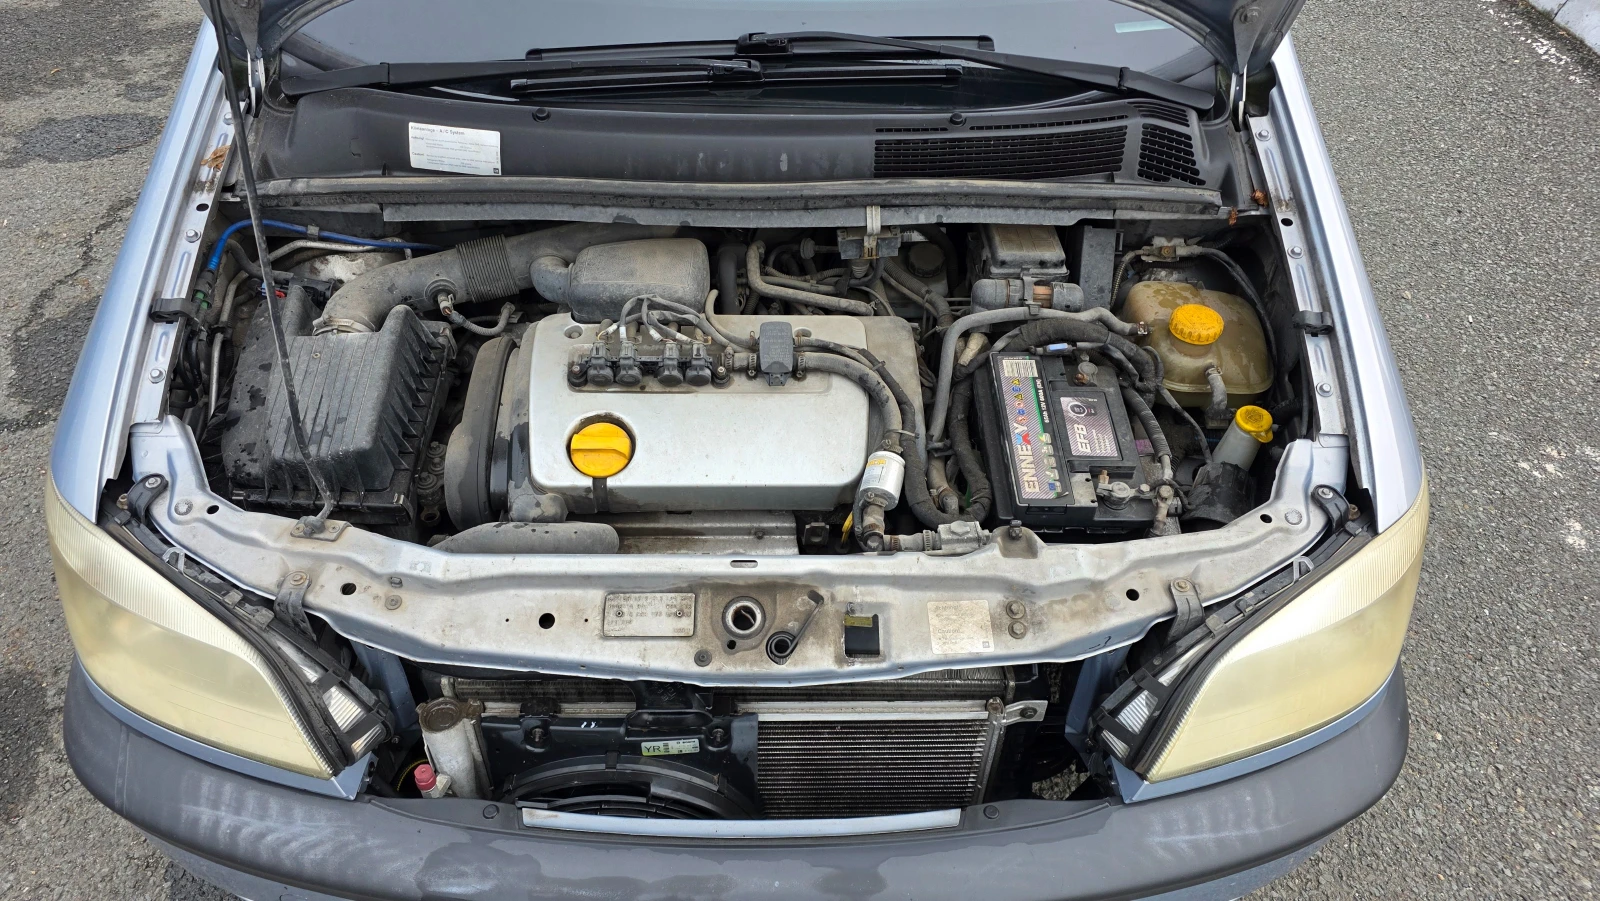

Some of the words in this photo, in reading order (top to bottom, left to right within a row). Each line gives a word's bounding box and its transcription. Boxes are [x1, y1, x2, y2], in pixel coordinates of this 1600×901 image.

[1073, 423, 1092, 453] EFB
[1013, 422, 1040, 493] ENNEXY
[644, 745, 662, 753] YR
